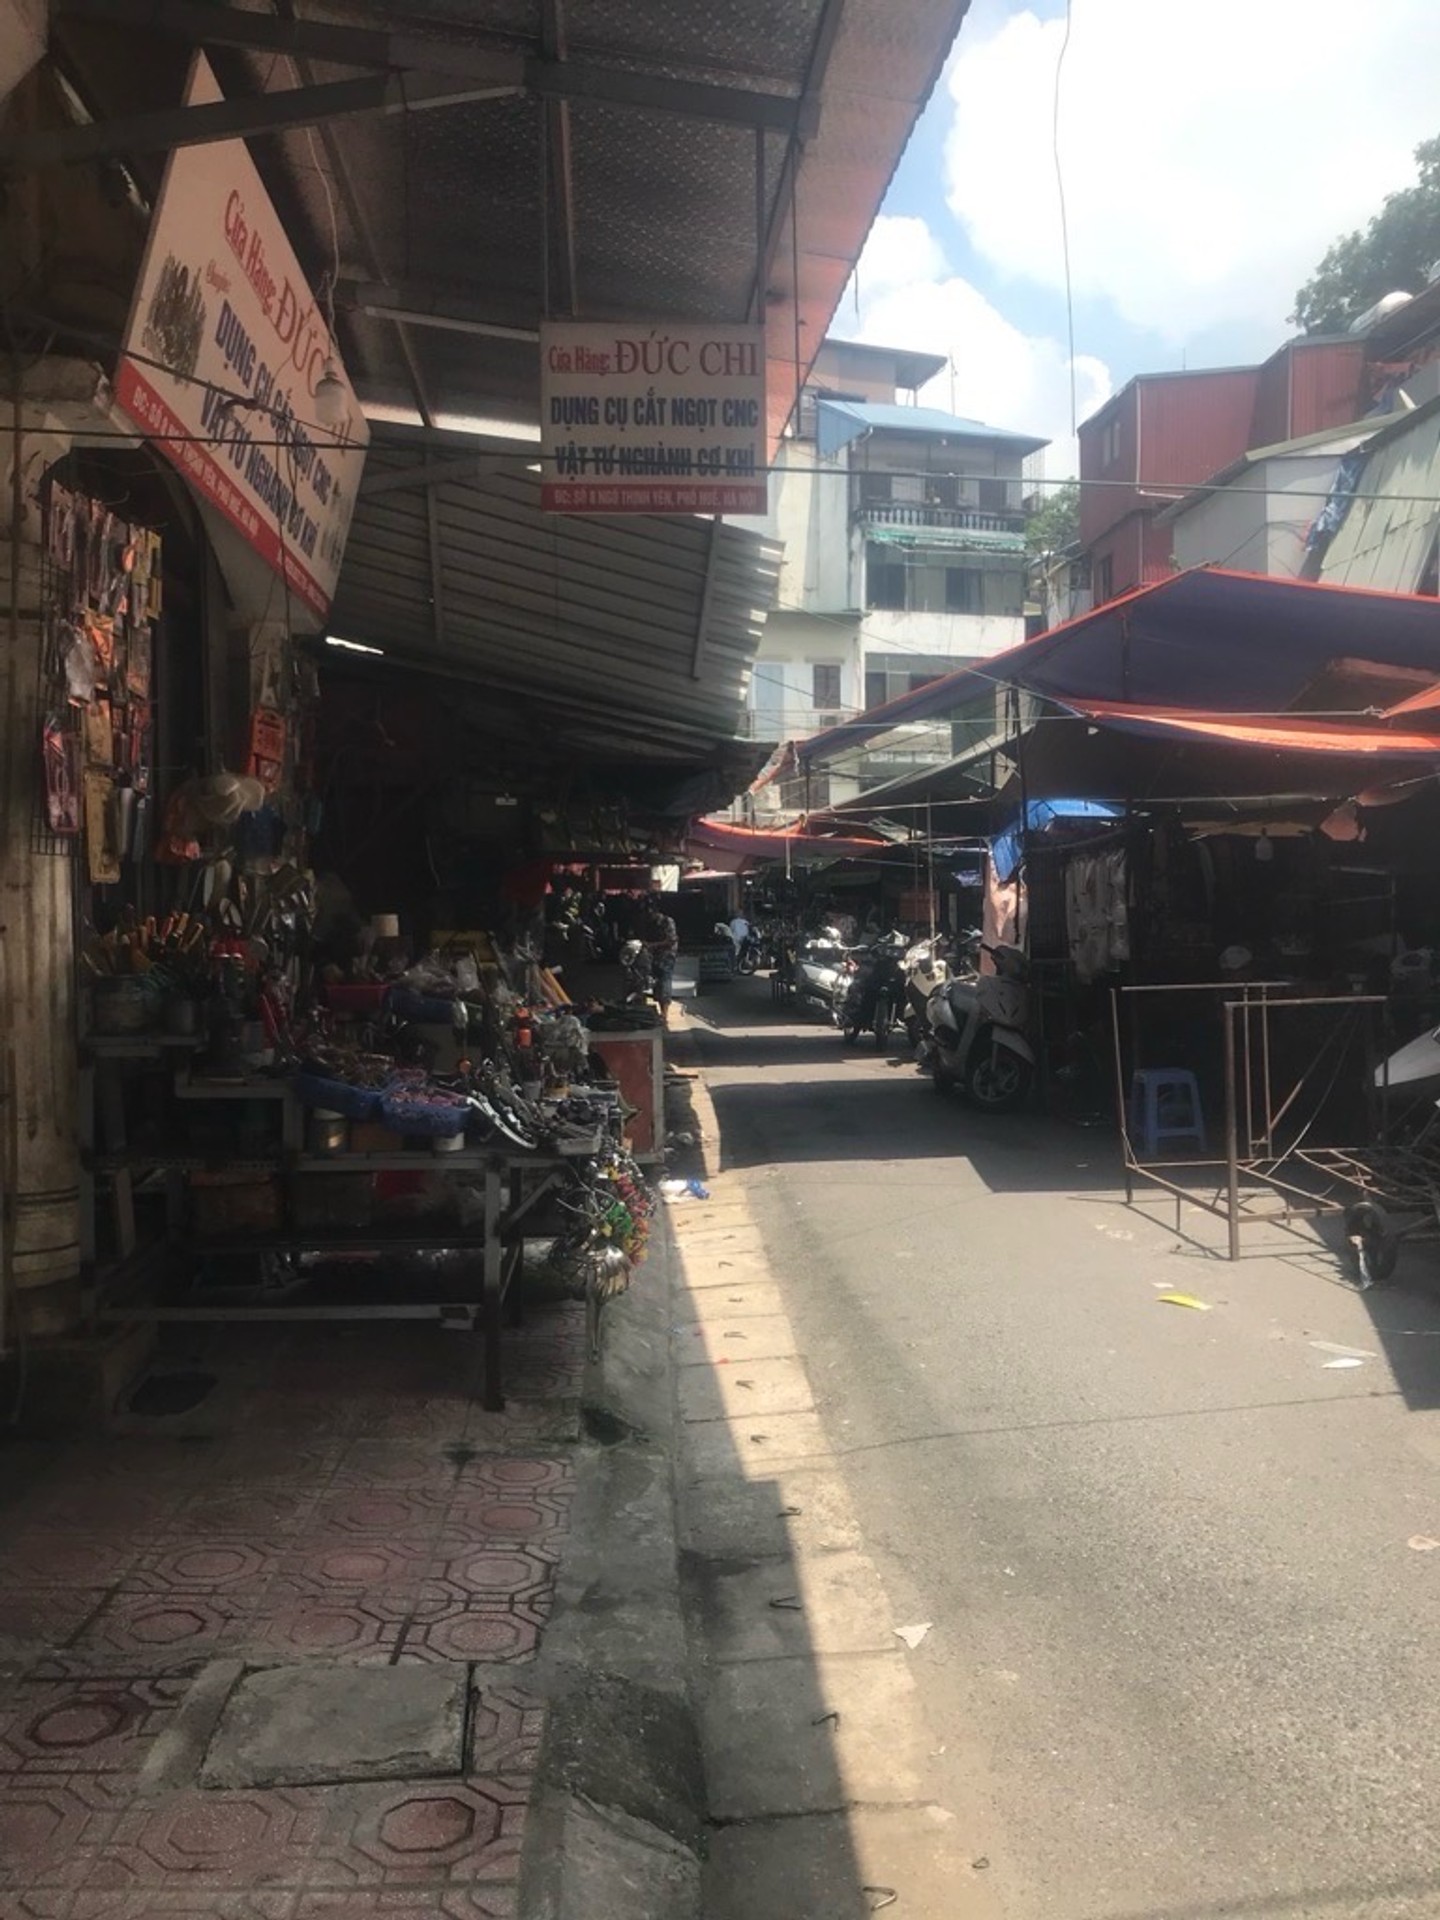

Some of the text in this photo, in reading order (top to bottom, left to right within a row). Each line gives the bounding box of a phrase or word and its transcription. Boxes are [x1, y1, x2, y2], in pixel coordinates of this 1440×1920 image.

[215, 299, 256, 388] DỤNG
[275, 276, 325, 398] ĐỨC
[615, 330, 690, 375] ĐỨC
[700, 340, 760, 376] CHI
[551, 386, 759, 433] DỤNG CỤ CẮT NGỌT CNC
[555, 440, 589, 481] VẬT
[591, 445, 617, 476] TƯ
[698, 446, 721, 477] CƠ
[725, 444, 756, 478] KHÍ
